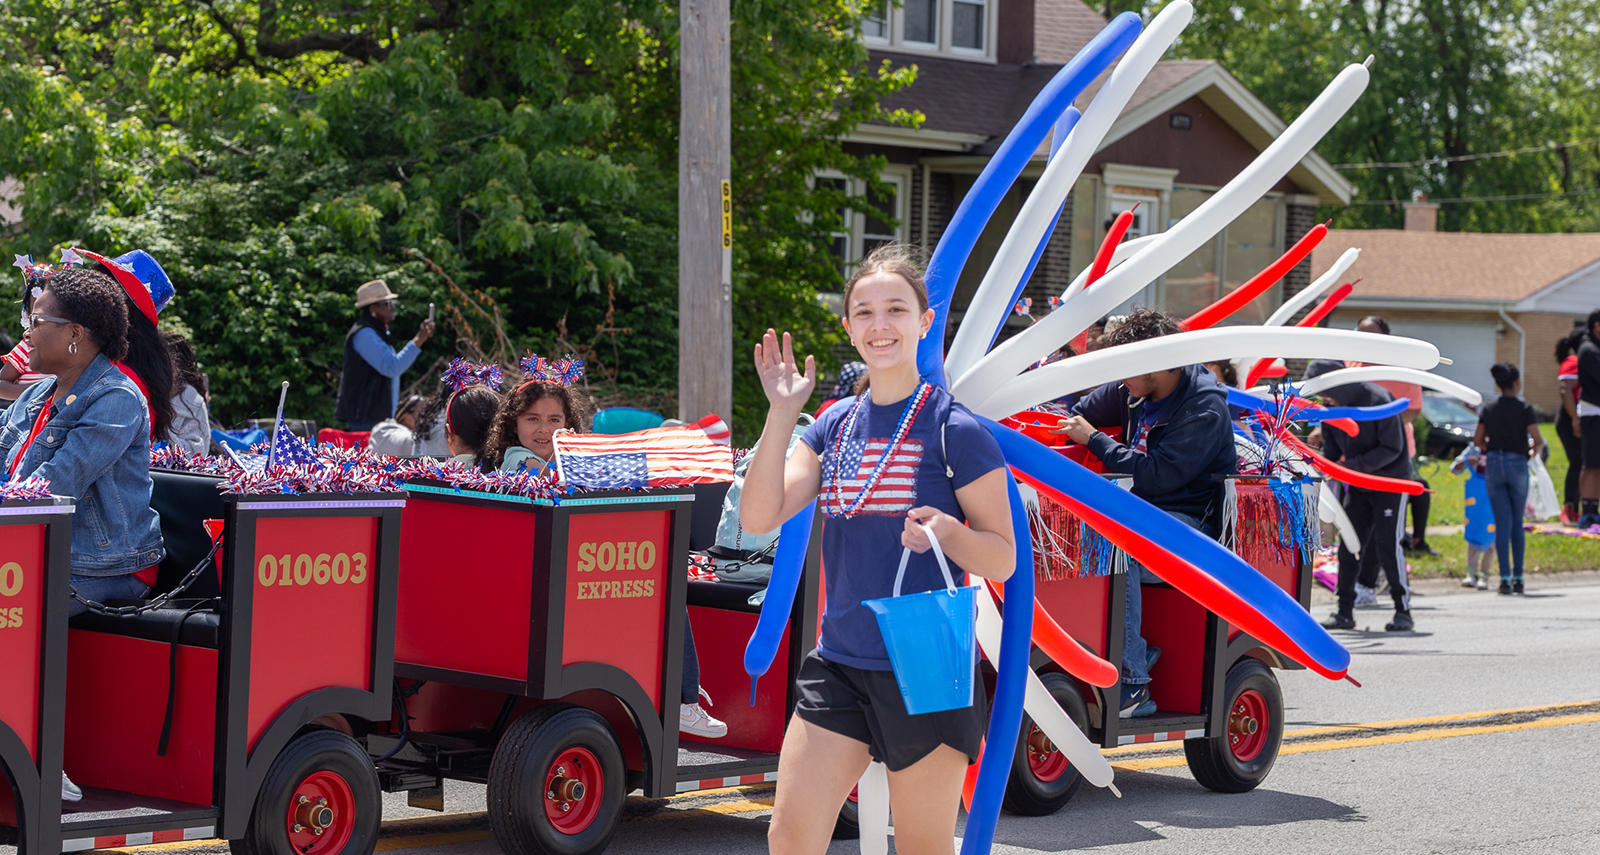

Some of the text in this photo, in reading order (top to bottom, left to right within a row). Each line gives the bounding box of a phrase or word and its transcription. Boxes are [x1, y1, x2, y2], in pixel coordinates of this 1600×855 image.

[258, 552, 367, 587] 010603
[577, 540, 656, 572] SOHO
[577, 579, 655, 600] EXPRESS
